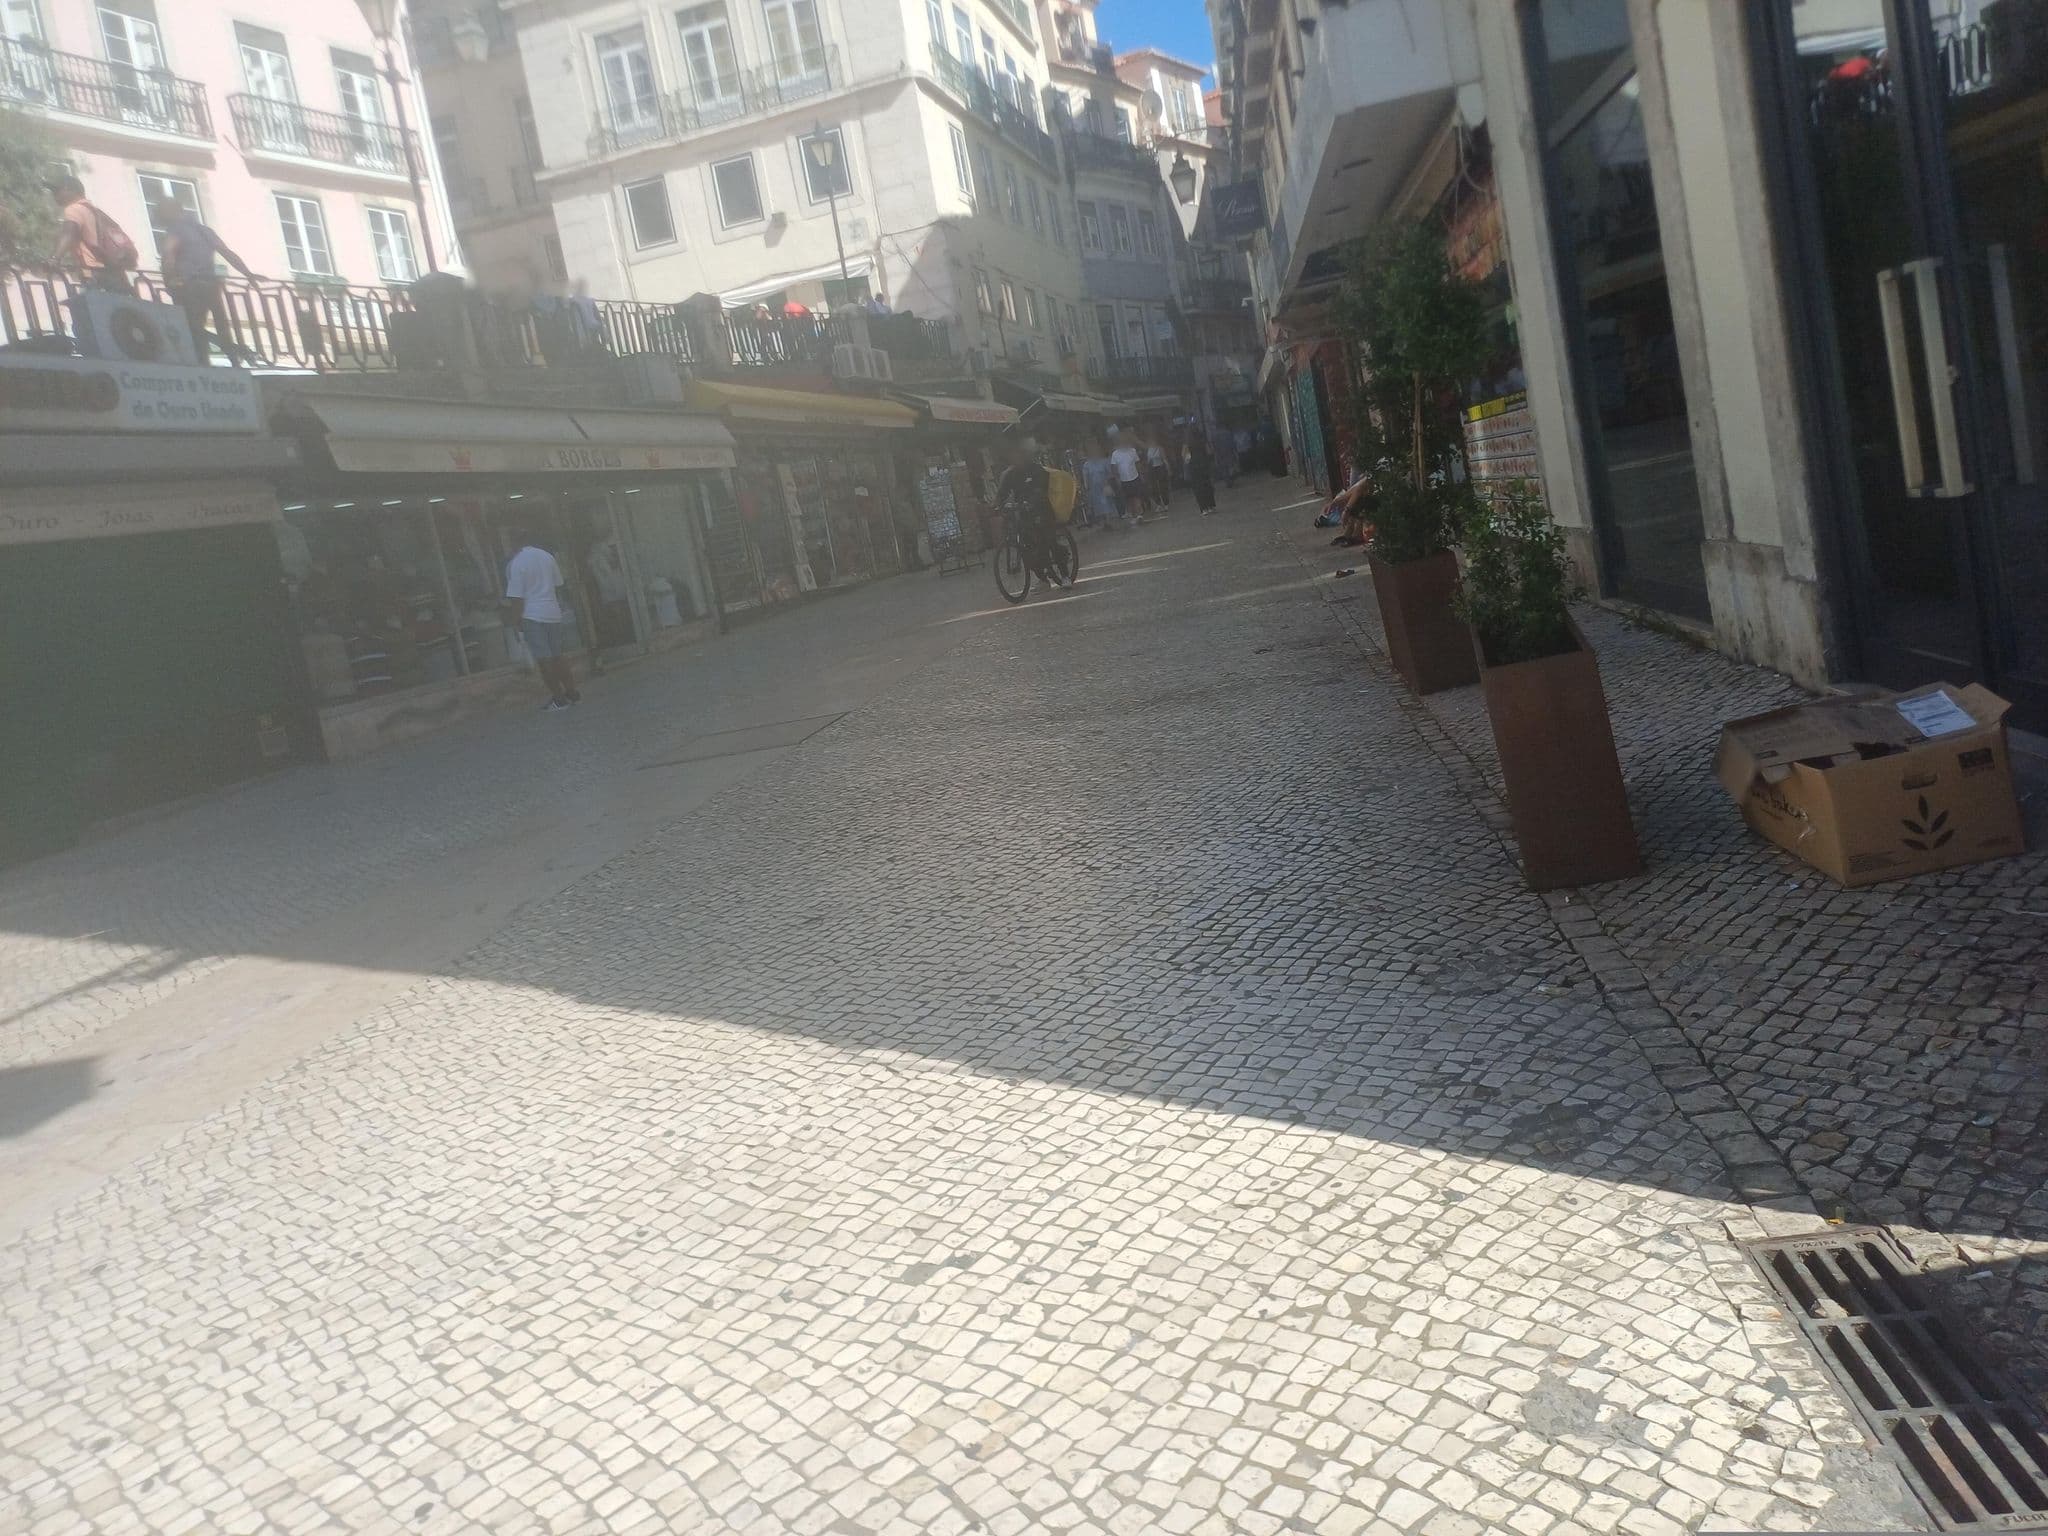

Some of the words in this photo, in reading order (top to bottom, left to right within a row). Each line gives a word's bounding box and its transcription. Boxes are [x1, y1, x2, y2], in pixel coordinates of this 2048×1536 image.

[120, 372, 184, 396] Compra
[188, 380, 197, 392] e
[157, 401, 197, 418] Ouro
[558, 448, 623, 468] BORGES
